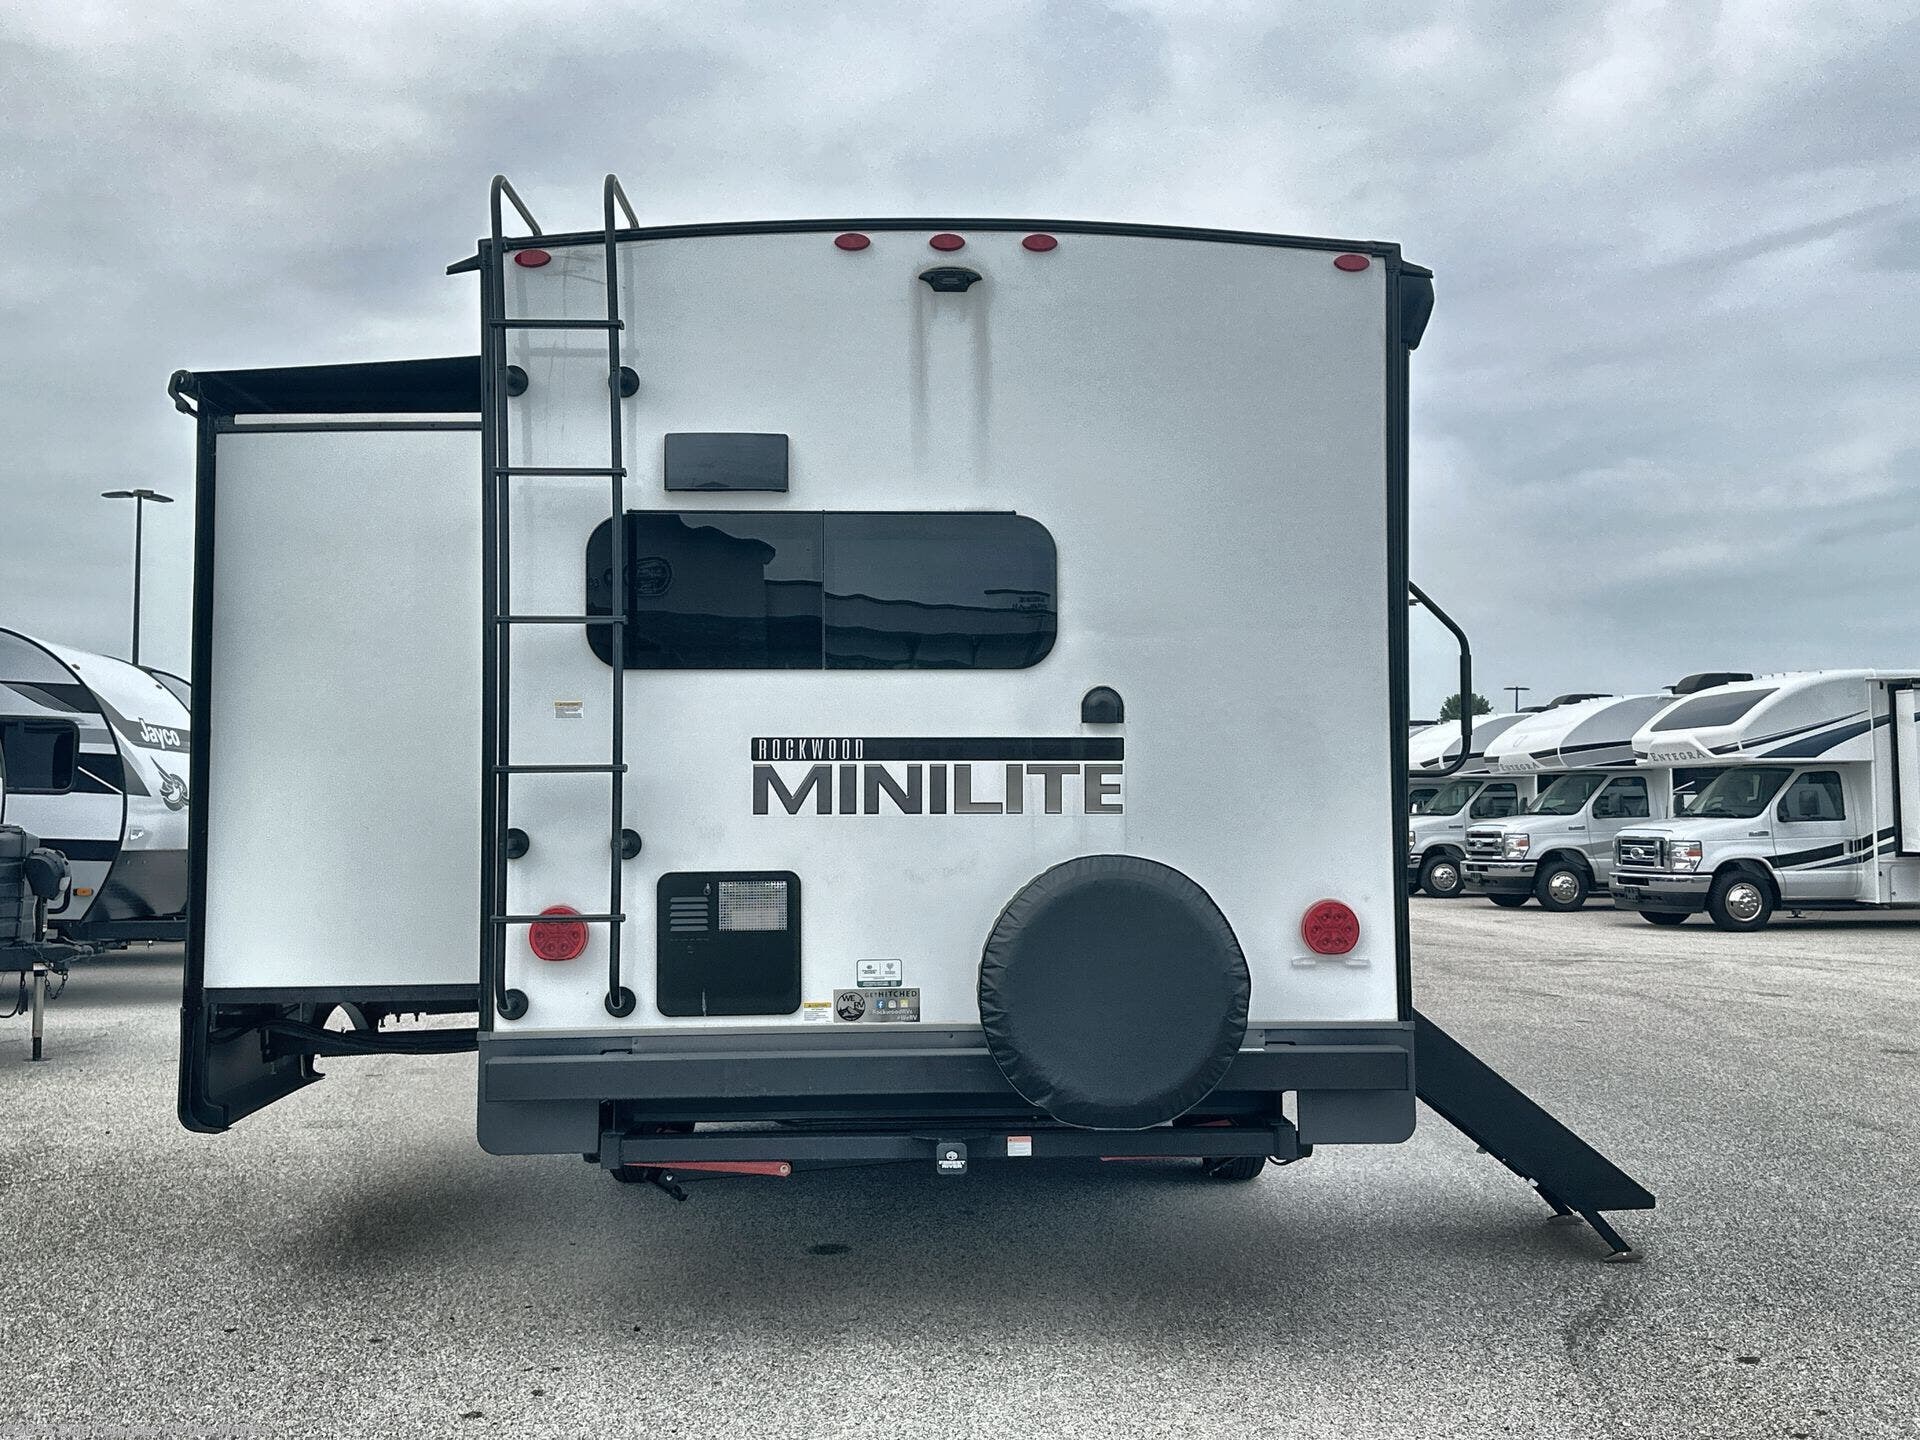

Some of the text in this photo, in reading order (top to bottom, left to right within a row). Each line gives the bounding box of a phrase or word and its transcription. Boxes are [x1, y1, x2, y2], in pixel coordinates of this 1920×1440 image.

[138, 717, 181, 749] Jayco
[757, 738, 865, 760] ROCKWOOD
[1650, 749, 1706, 761] ENTEGRA
[752, 763, 1124, 815] MINILITE
[878, 990, 917, 998] HITCHED
[853, 999, 865, 1008] RV
